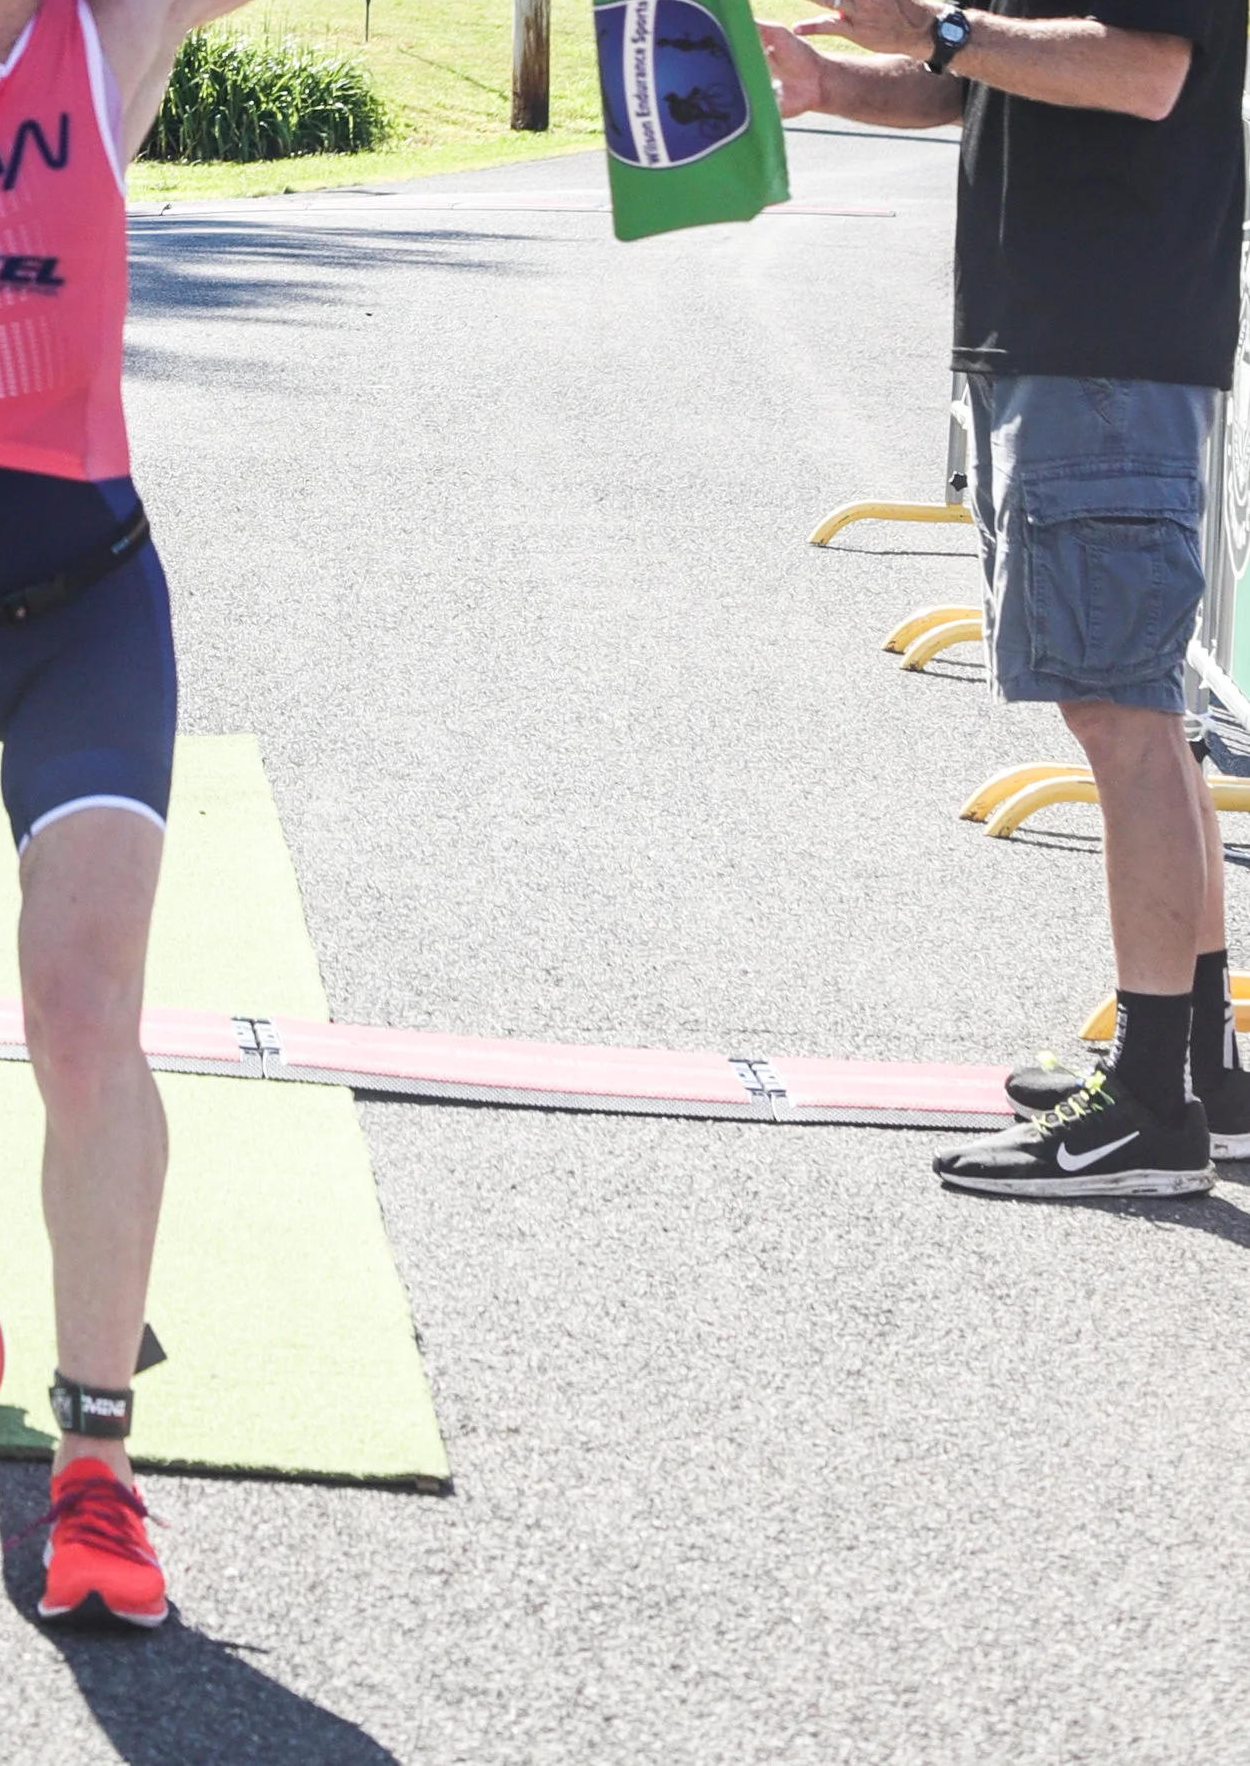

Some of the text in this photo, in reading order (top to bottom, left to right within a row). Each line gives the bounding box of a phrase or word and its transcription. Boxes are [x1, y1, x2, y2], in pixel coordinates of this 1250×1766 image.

[630, 0, 661, 164] Wilson Endurance Sports
